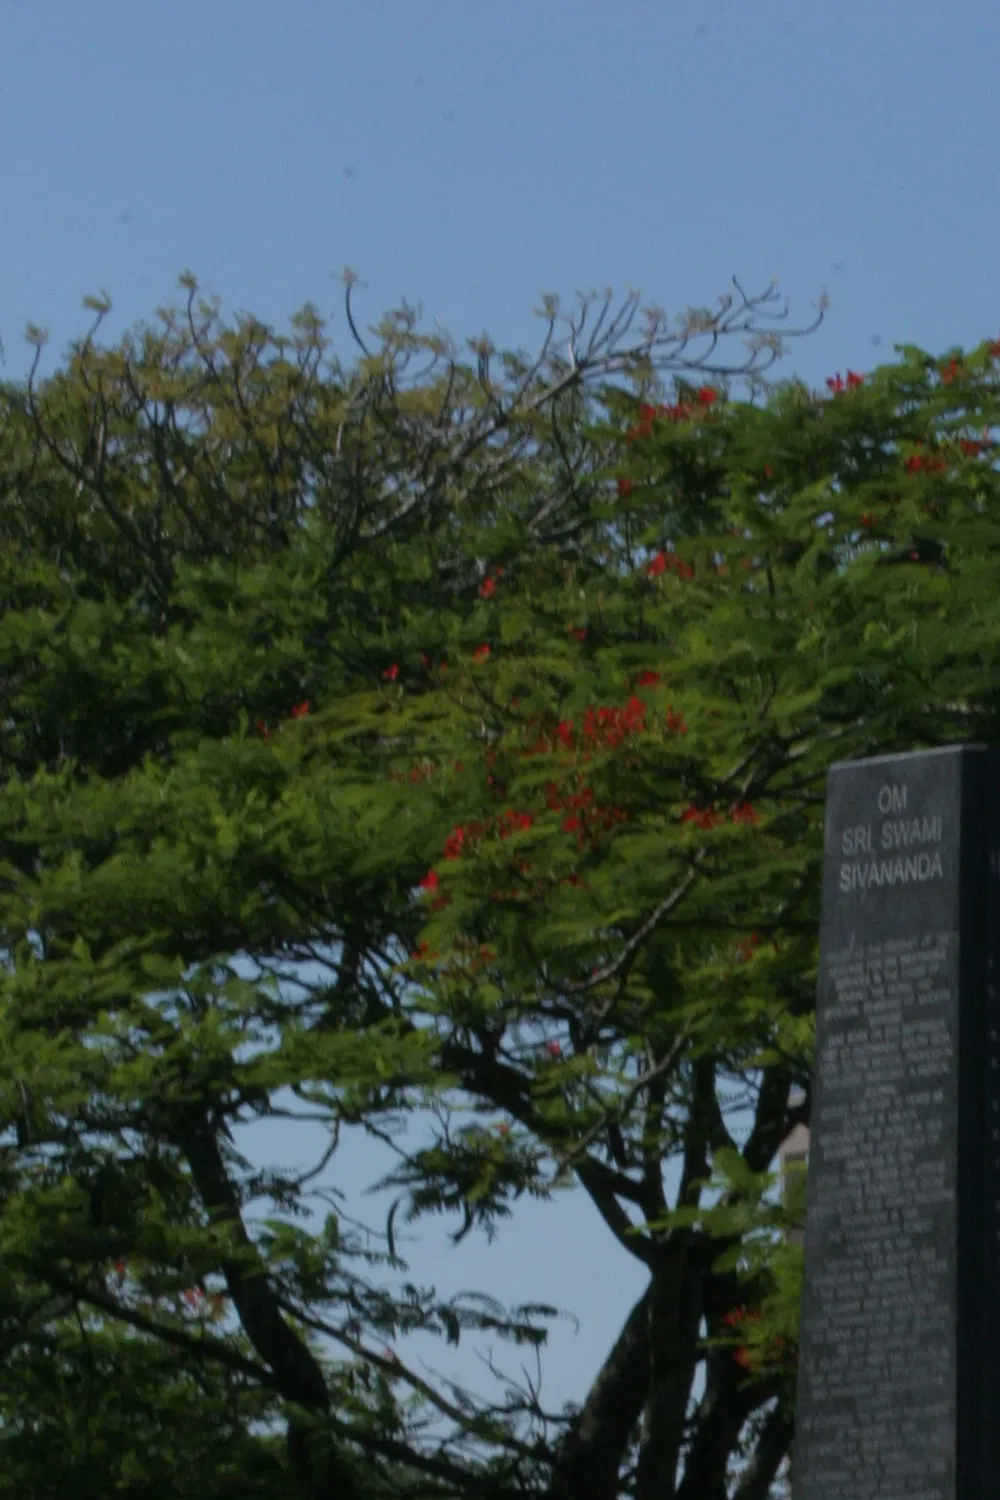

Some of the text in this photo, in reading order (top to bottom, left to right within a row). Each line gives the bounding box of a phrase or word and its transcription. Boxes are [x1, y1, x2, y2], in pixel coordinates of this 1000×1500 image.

[877, 784, 908, 814] OM
[881, 816, 943, 850] SWAMI
[839, 851, 944, 893] SIVANANDA
